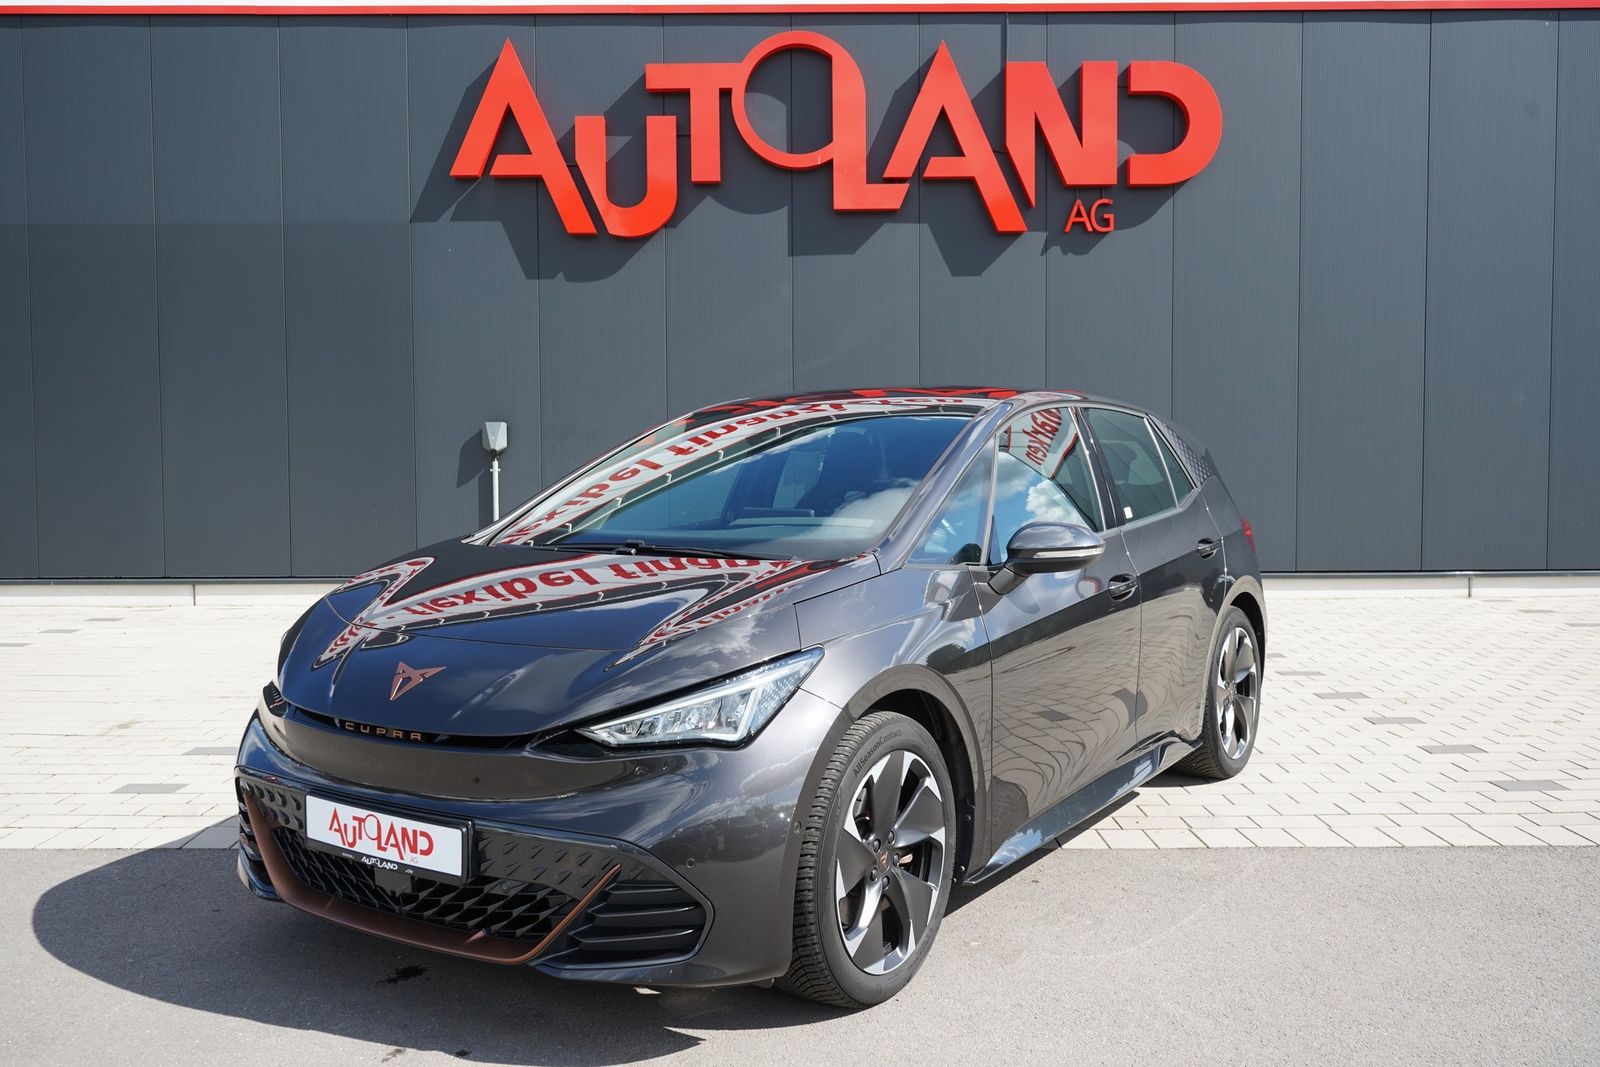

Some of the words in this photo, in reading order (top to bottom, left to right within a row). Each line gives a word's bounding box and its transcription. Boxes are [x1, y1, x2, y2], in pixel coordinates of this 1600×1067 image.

[450, 30, 1223, 238] AUTOLAND
[1064, 199, 1115, 233] AG
[345, 721, 421, 741] CUPRA
[328, 806, 434, 861] AUTOLAND
[361, 856, 398, 870] AUTOLAND
